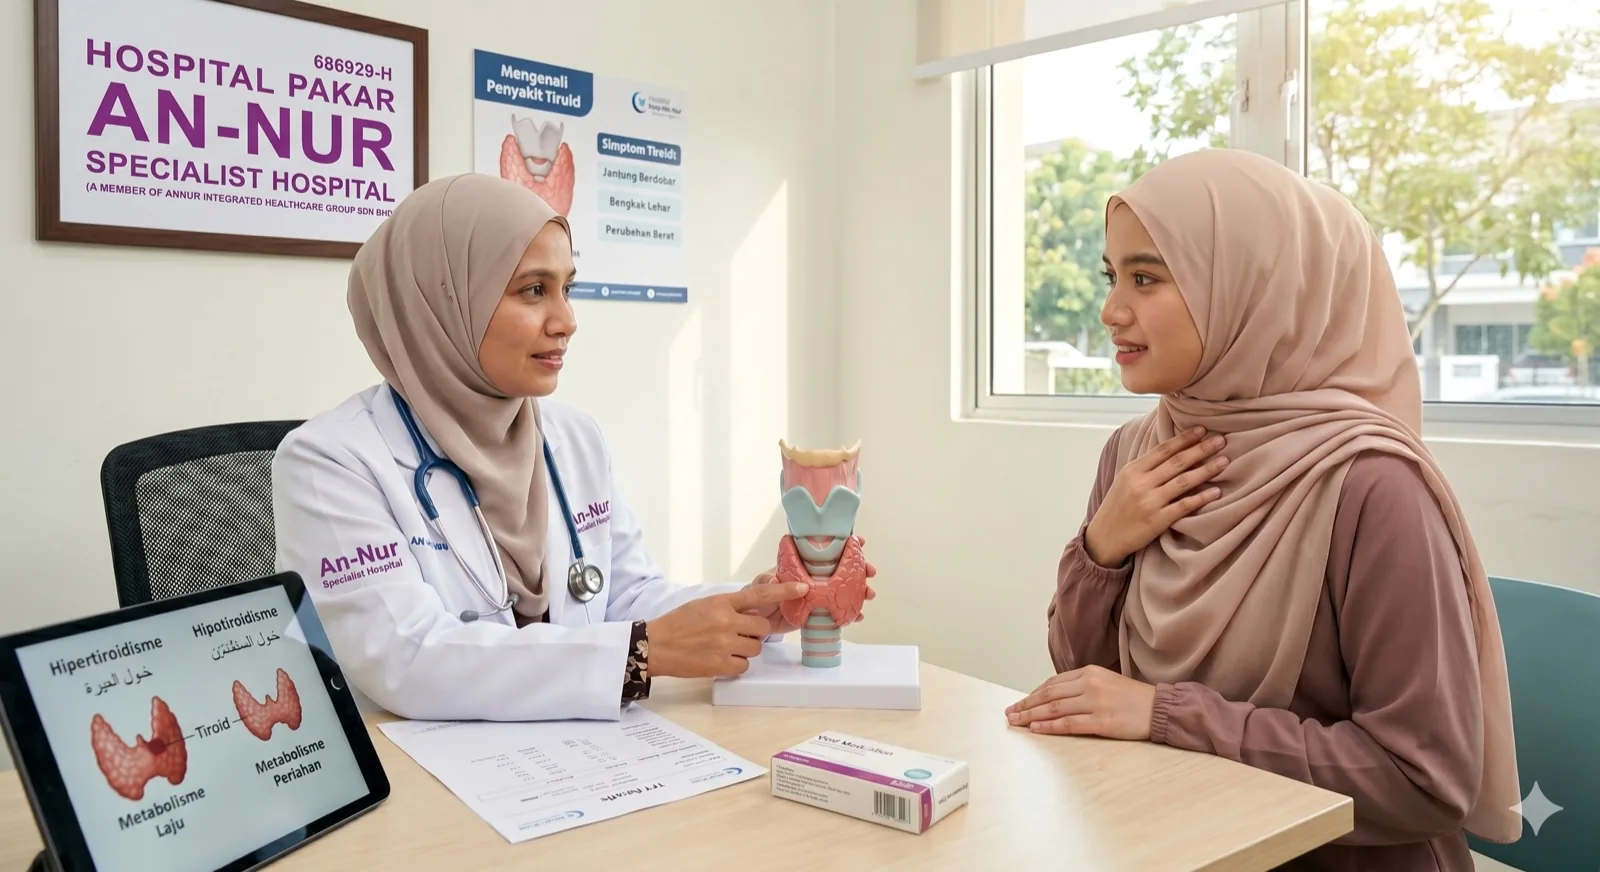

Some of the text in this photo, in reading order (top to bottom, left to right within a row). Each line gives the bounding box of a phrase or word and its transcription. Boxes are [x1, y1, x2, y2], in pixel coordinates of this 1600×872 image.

[86, 38, 396, 113] HOSPITAL PAKAR
[313, 54, 392, 81] 686929-H
[500, 64, 568, 90] Mengenali
[486, 79, 581, 109] Penyakit Tiruid
[86, 81, 395, 172] AN-NUR
[602, 137, 646, 156] Simptom
[86, 149, 396, 203] SPECIALIST HOSPITAL
[602, 167, 637, 183] Jantung
[86, 182, 98, 193] (A
[99, 183, 146, 196] MEMBER
[149, 187, 163, 197] OF
[165, 189, 201, 201] ANNUR
[203, 192, 263, 206] INTEGRATED
[265, 198, 324, 212] HEALTHCARE
[325, 204, 356, 214] GROUP
[357, 207, 374, 216] SDN
[609, 196, 646, 211] Bengkak
[652, 229, 675, 241] Berat
[319, 541, 399, 578] An-Nur
[322, 559, 403, 589] Specialist Hospital
[192, 605, 279, 638] Hipotiroidisme
[49, 635, 163, 677] Hipertiroidisme
[195, 716, 231, 742] Tiroid
[254, 737, 326, 775] Metabolisme
[272, 758, 322, 787] Periahan
[117, 786, 206, 831] Metabolisme
[156, 816, 185, 838] Laju
